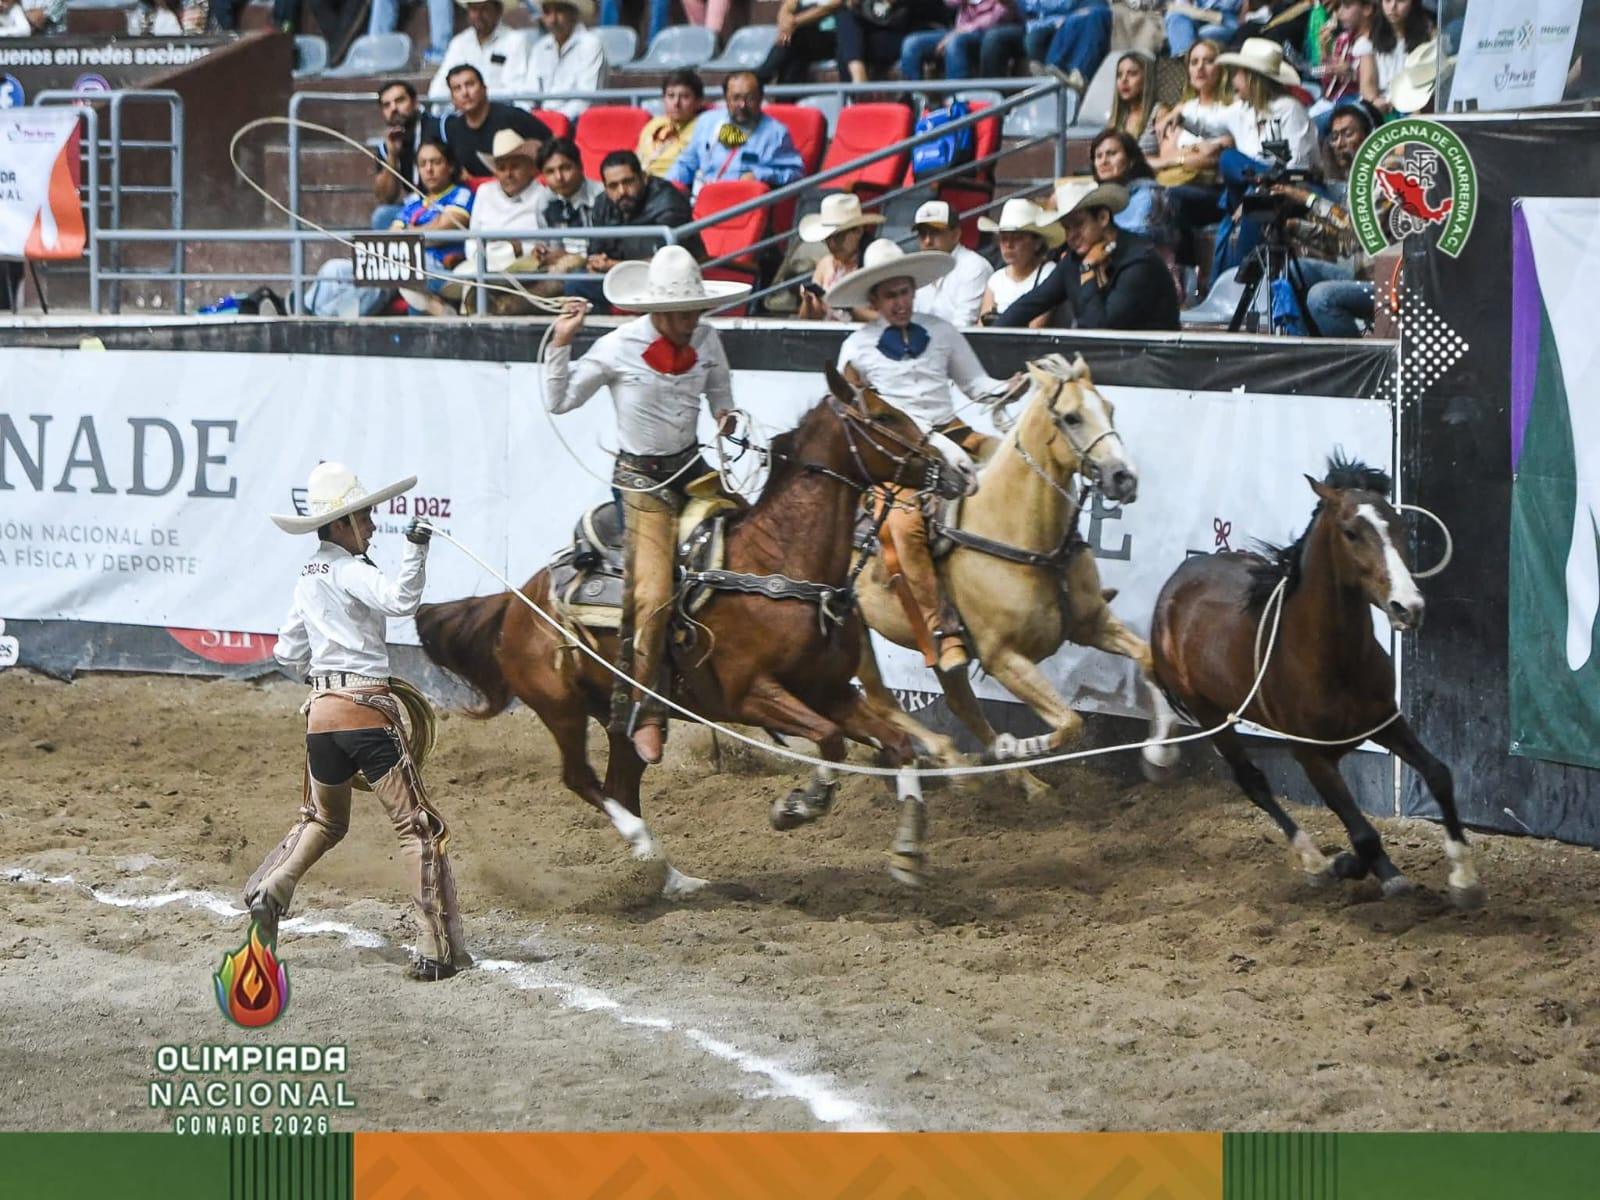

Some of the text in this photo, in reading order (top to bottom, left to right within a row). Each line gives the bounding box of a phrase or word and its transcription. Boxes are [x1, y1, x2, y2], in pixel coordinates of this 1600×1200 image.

[55, 49, 79, 65] en
[80, 45, 132, 65] redes
[354, 241, 424, 280] PALCO 1
[0, 413, 238, 499] NADE
[414, 496, 451, 517] paz
[42, 525, 144, 545] NACIONAL
[151, 529, 181, 547] DE
[15, 545, 77, 569] FÍSICA
[86, 553, 96, 569] Y
[102, 554, 197, 575] DEPORTE
